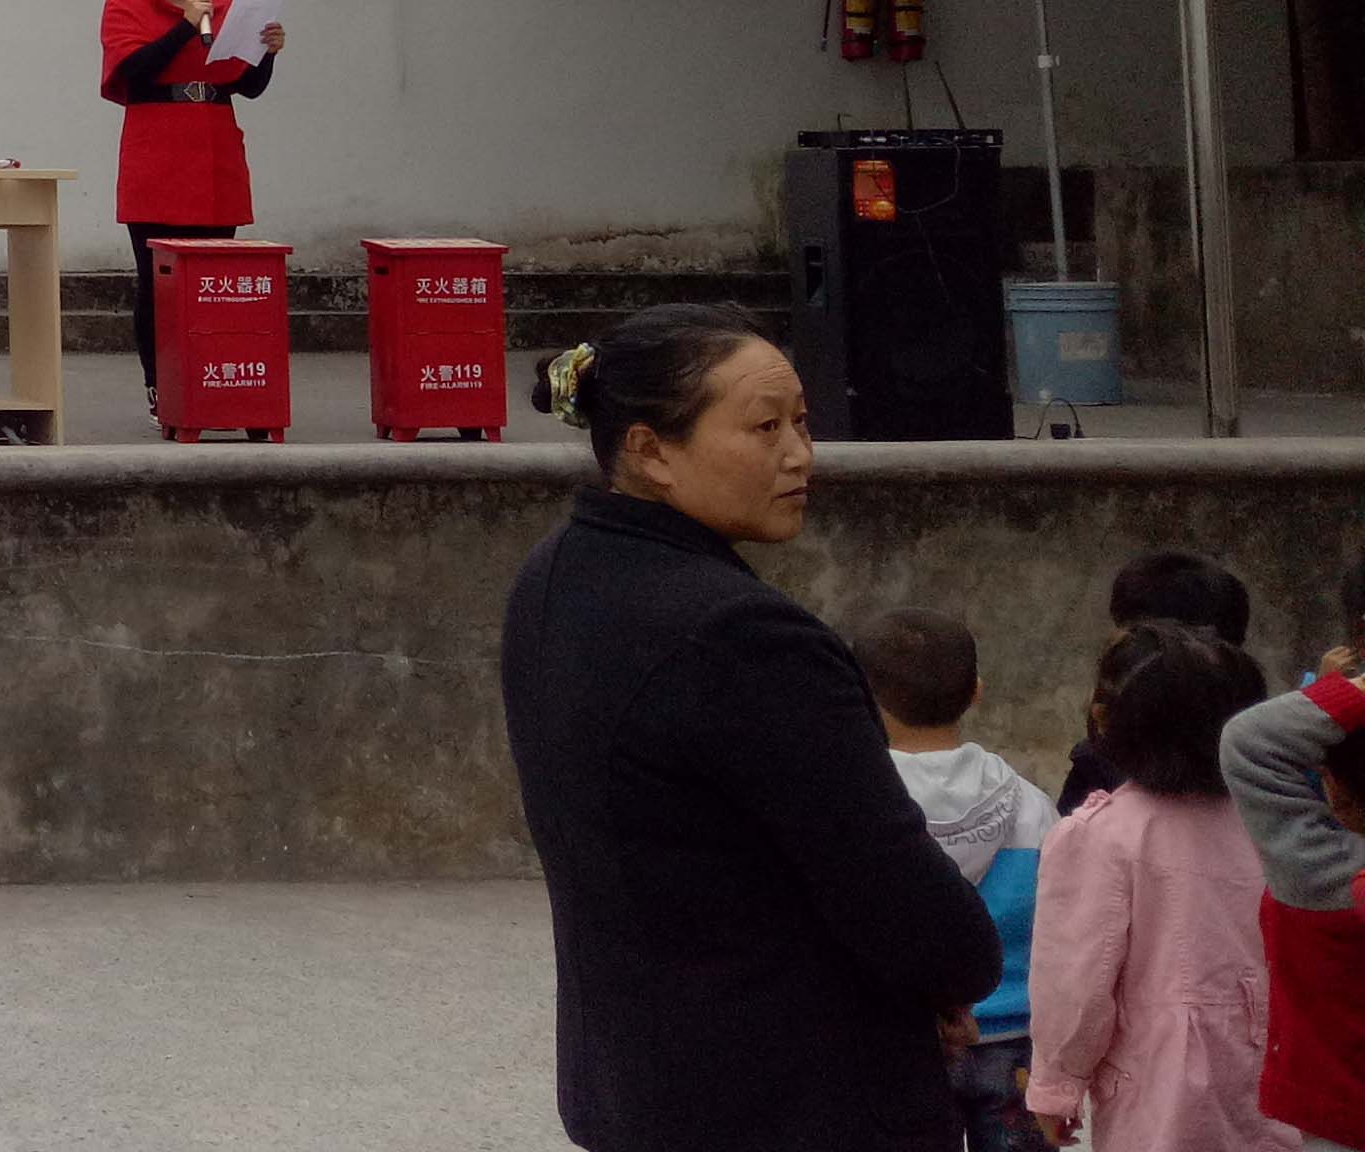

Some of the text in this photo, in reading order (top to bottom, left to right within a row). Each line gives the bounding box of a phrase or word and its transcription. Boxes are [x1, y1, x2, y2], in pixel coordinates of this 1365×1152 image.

[198, 276, 272, 294] 灭火器箱
[415, 277, 487, 295] 灭火器箱
[203, 362, 266, 380] 火警119
[420, 364, 482, 382] 火警119
